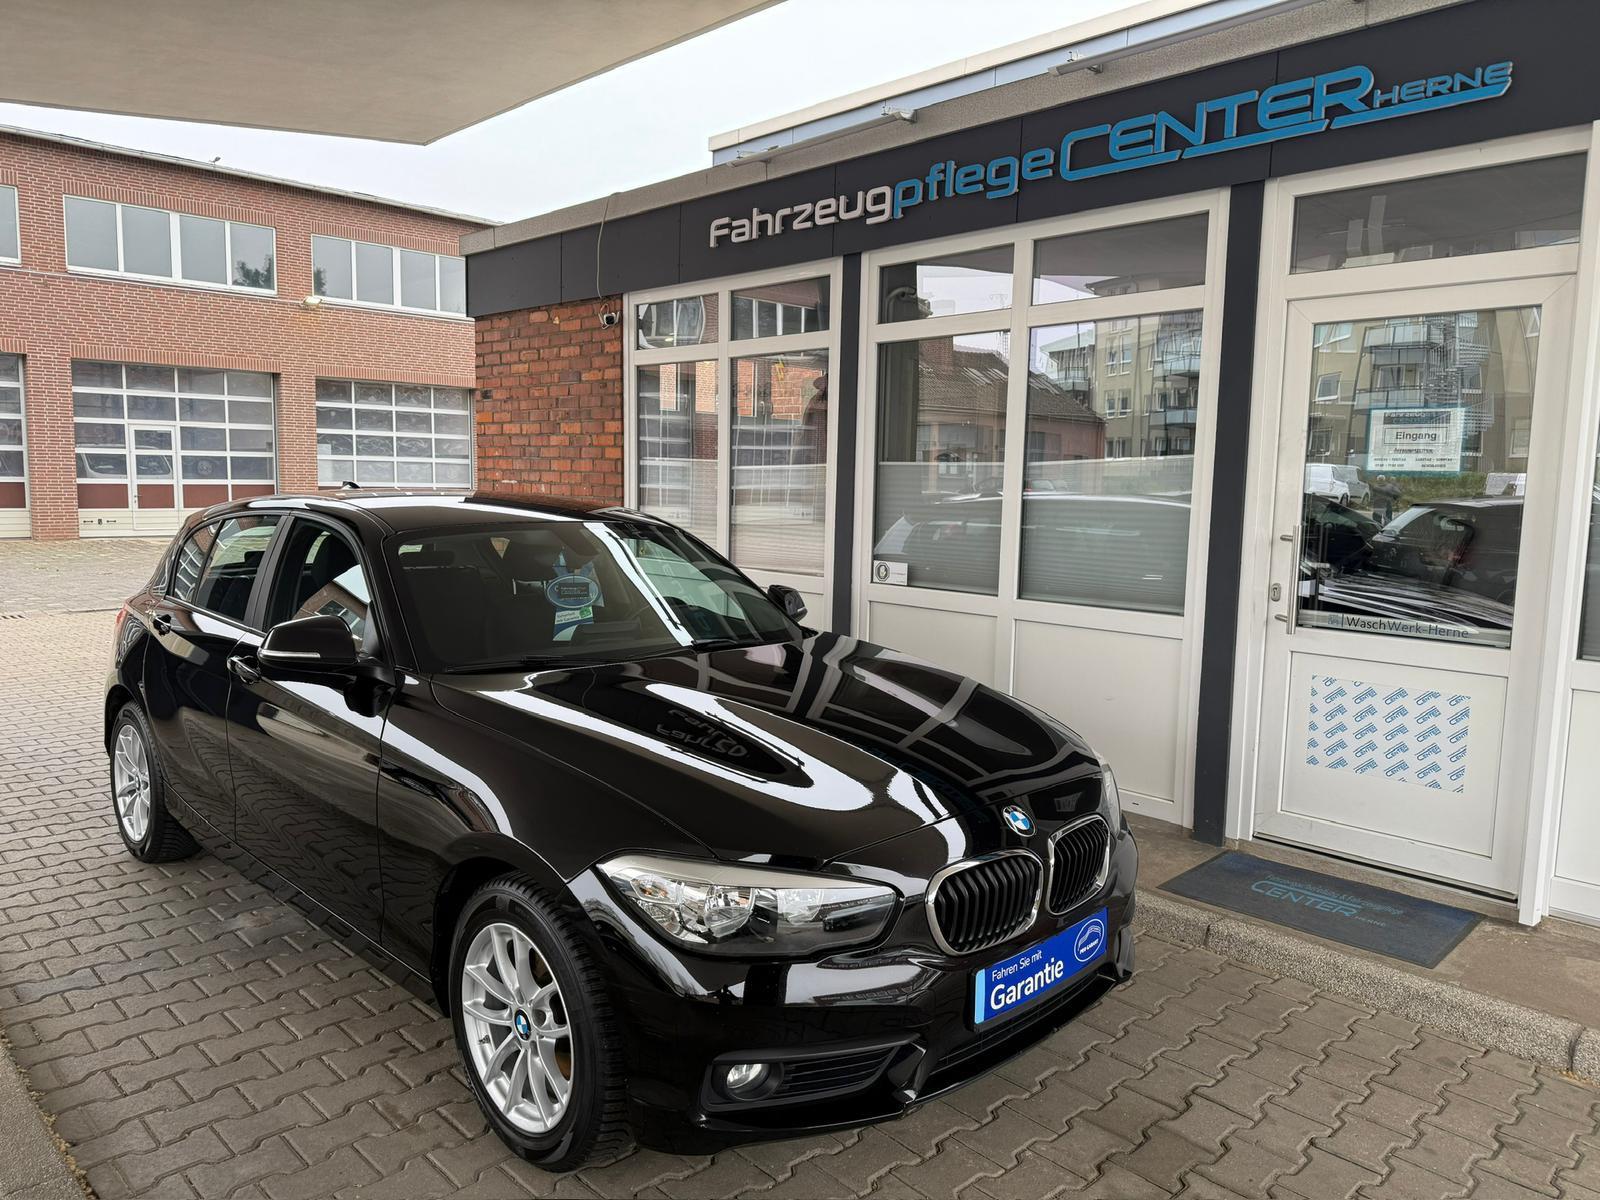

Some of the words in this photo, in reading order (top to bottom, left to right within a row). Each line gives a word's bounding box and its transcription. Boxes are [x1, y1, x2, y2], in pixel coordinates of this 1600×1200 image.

[1373, 61, 1515, 112] HERNE
[1395, 431, 1438, 441] Eingang
[1346, 615, 1469, 639] WaschWerk-Herne
[1251, 880, 1361, 917] CENTER
[991, 959, 1018, 982] Fahren
[1019, 956, 1030, 971] Sie
[1031, 950, 1042, 965] mit
[990, 957, 1064, 1010] Garantie
